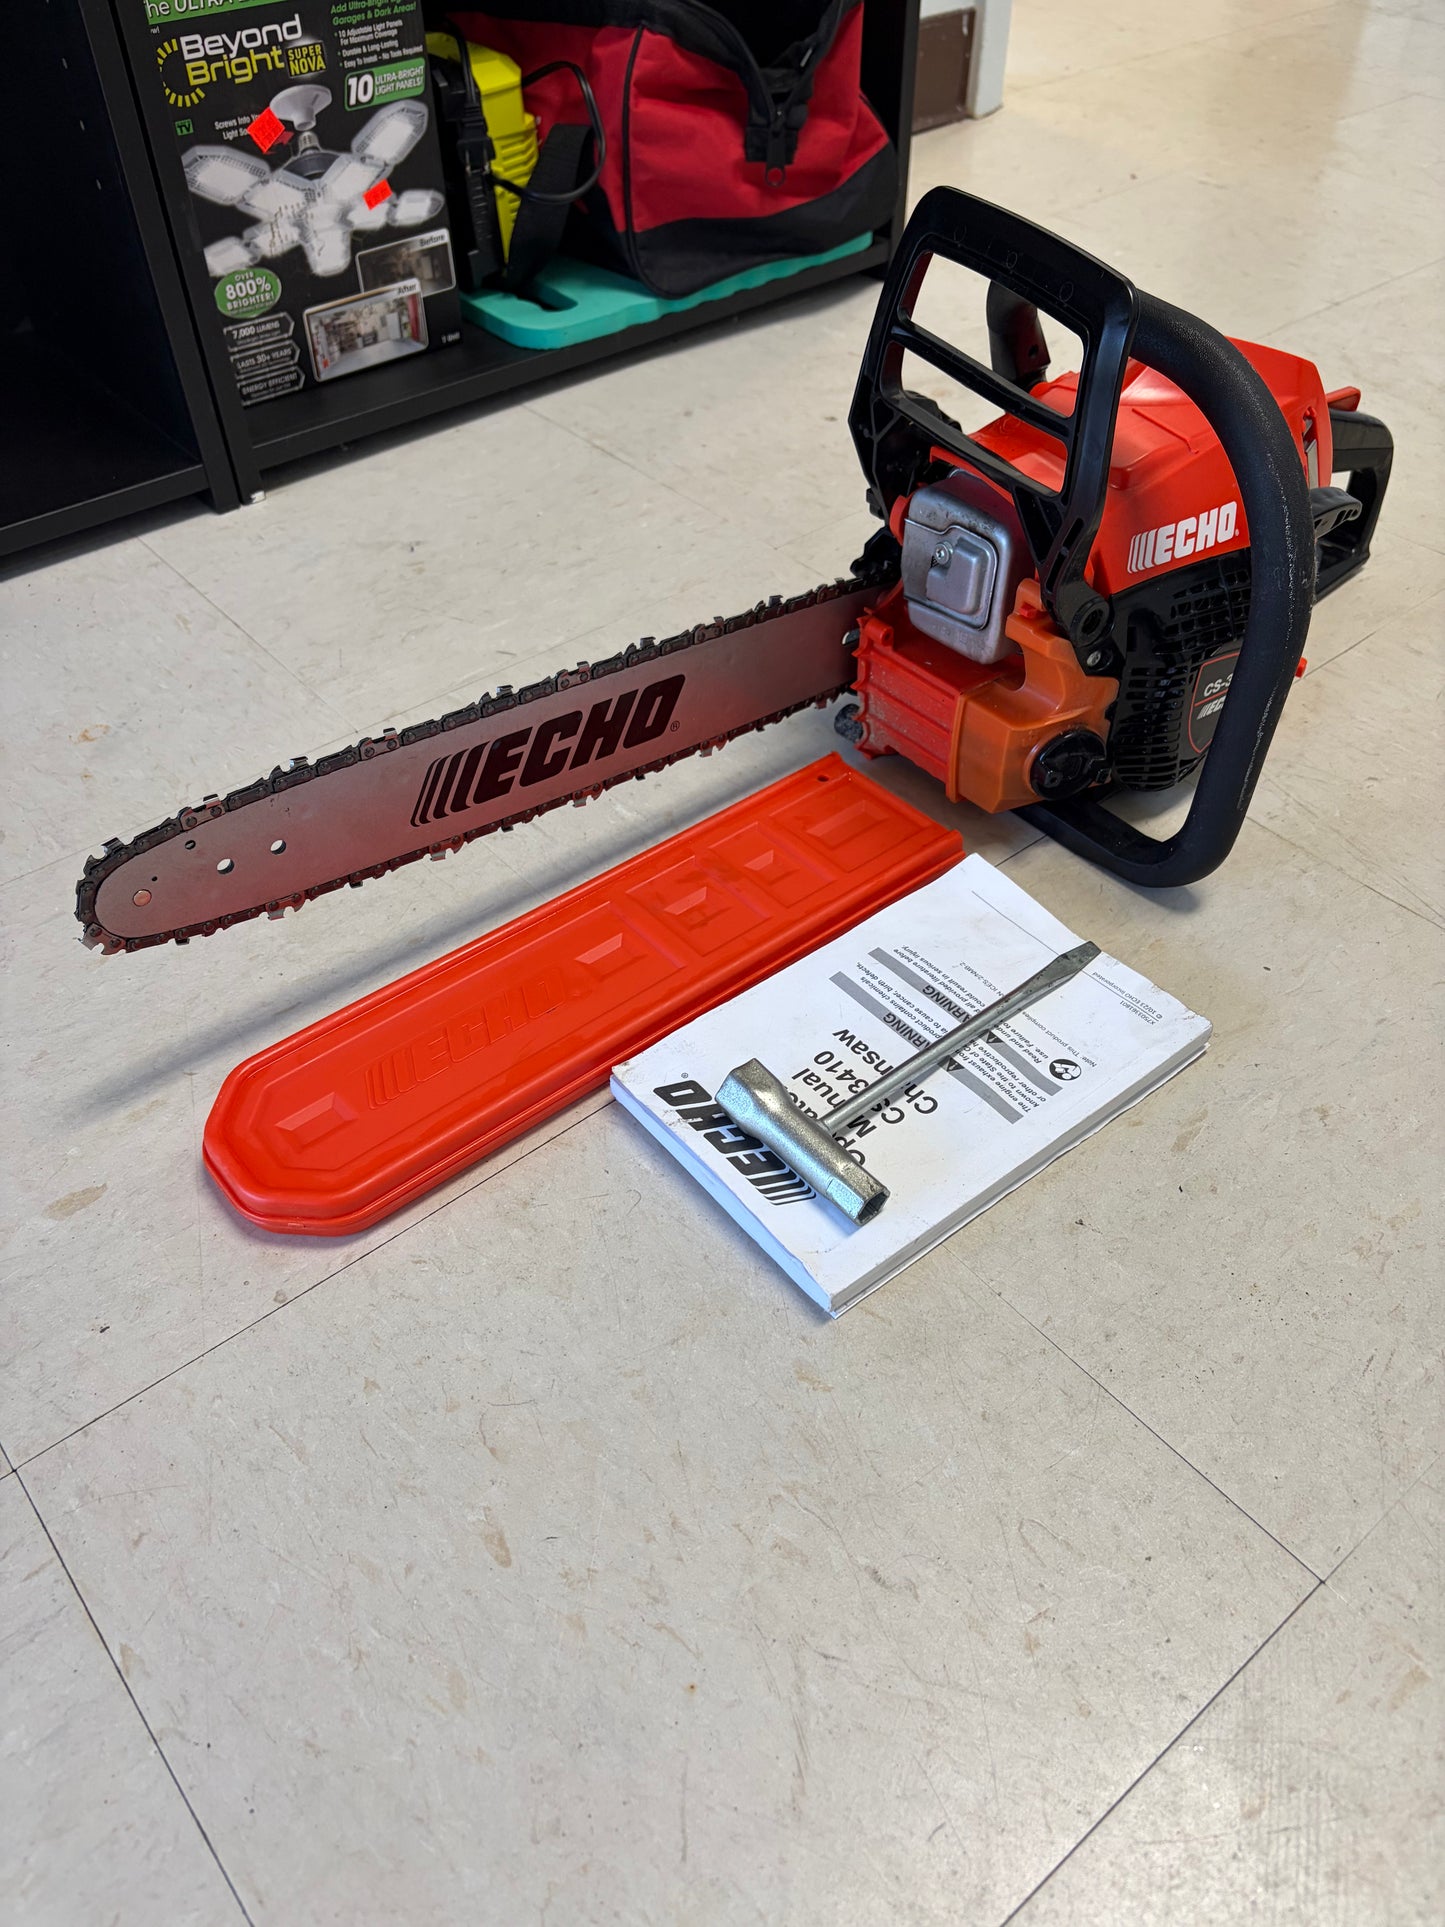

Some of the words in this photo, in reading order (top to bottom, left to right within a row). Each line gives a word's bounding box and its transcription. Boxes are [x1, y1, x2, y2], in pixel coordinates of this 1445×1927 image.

[331, 3, 347, 14] Add
[332, 13, 365, 25] Garages
[367, 10, 372, 19] &
[374, 7, 391, 17] Dark
[393, 2, 416, 13] Areas!
[373, 22, 385, 31] Light
[180, 13, 302, 60] Beyond
[288, 44, 321, 60] SUPER
[186, 46, 284, 86] Bright
[290, 55, 326, 76] NOVA
[375, 66, 424, 85] ULTRA-BRIGHT
[348, 74, 374, 106] 10
[375, 83, 395, 95] LIGHT
[214, 119, 237, 130] Screws
[238, 116, 250, 125] Into
[223, 128, 238, 140] Light
[234, 272, 254, 281] OVER
[226, 276, 271, 300] 800%
[226, 292, 274, 310] BRIGHTER!
[232, 326, 255, 340] 7,000
[1153, 501, 1237, 568] ECHO
[1204, 673, 1233, 696] CS-3
[472, 674, 686, 804] ECHO
[893, 948, 913, 963] before
[912, 961, 940, 982] literature
[919, 957, 942, 974] serious
[860, 976, 890, 1000] chemicals
[877, 979, 893, 992] birth
[937, 980, 968, 1002] provided
[947, 978, 968, 993] result
[1091, 971, 1126, 996] Incorporated
[892, 990, 915, 1008] cancer,
[965, 992, 985, 1007] could
[1124, 992, 1141, 1004] ECHO
[889, 999, 916, 1020] contains
[914, 1007, 934, 1022] cause
[1139, 1002, 1156, 1015] 10/23
[410, 967, 566, 1083] ECHO
[1021, 1011, 1046, 1031] complies
[914, 1019, 943, 1042] product
[1010, 1028, 1034, 1048] Failure
[1044, 1030, 1069, 1047] product
[1008, 1037, 1024, 1048] and
[1066, 1046, 1080, 1057] This
[1022, 1048, 1042, 1064] Read
[1034, 1047, 1048, 1059] use.
[832, 1028, 938, 1114] Chnsaw
[967, 1059, 996, 1081] exhaust
[978, 1046, 1020, 1081] reproductive
[979, 1057, 997, 1072] State
[996, 1072, 1008, 1082] the
[813, 1050, 905, 1124] CS3410
[994, 1081, 1018, 1102] engine
[1017, 1081, 1038, 1096] other
[791, 1067, 877, 1138] Mnual
[1015, 1089, 1040, 1108] known
[1017, 1101, 1031, 1113] The
[653, 1079, 787, 1176] ECHO
